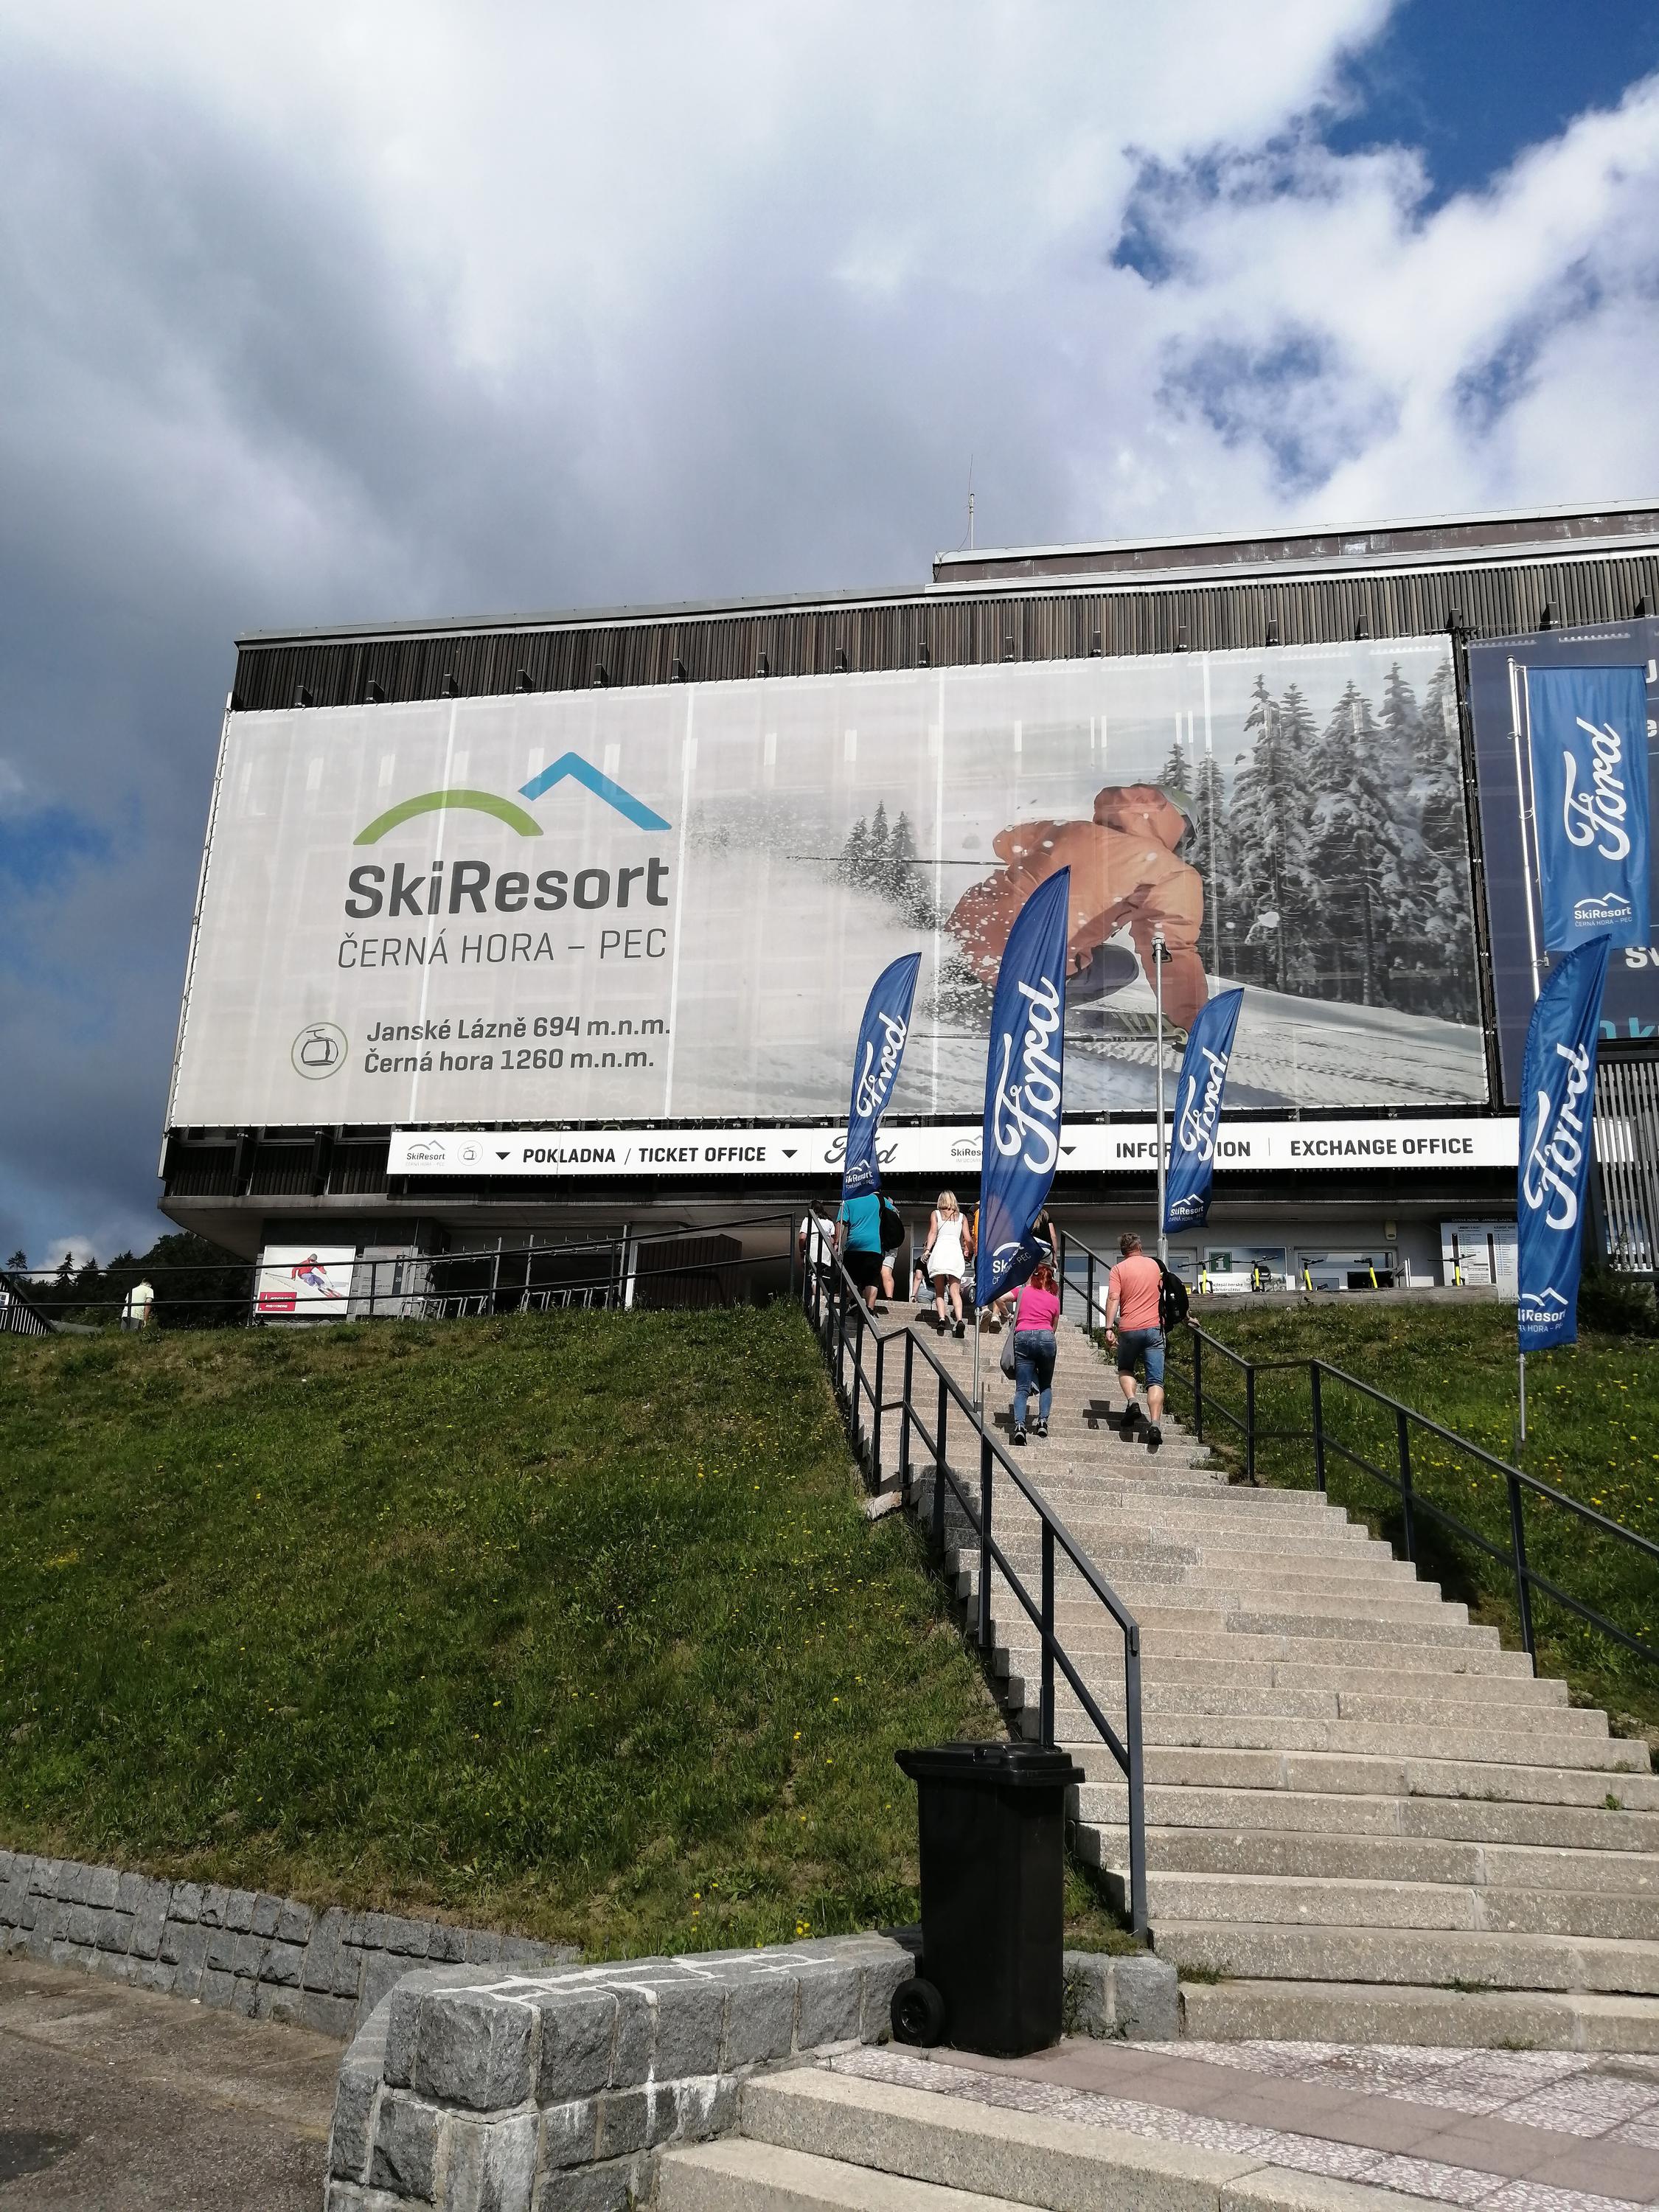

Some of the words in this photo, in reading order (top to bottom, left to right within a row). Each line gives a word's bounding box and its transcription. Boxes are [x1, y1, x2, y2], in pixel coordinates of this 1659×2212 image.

[1563, 716, 1630, 860] Ford
[344, 857, 669, 919] SkiResort
[1574, 906, 1632, 919] SkiResort
[338, 928, 448, 968] ČERNÁ
[461, 932, 554, 964] HORA
[600, 928, 667, 960] PEC
[366, 1018, 451, 1042] Janské
[458, 1017, 526, 1040] Lázně
[533, 1016, 580, 1037] 694
[587, 1019, 671, 1037] m.n.m.
[364, 1048, 433, 1074] Černá
[439, 1051, 493, 1071] hora
[501, 1048, 563, 1071] 1260
[570, 1052, 654, 1068] m.n.m.
[994, 976, 1061, 1175] Ford
[1180, 1046, 1229, 1162] Ford
[824, 1135, 899, 1164] Fd
[1290, 1139, 1397, 1156] EXCHANGE
[1402, 1138, 1473, 1155] OFFICE
[1523, 1043, 1590, 1230] Ford
[406, 1152, 445, 1161] SkiResort
[523, 1148, 616, 1164] POKLADNA
[639, 1147, 699, 1163] TICKET
[704, 1147, 766, 1162] OFFICE
[950, 1148, 983, 1157] SkiRes
[1016, 1252, 1032, 1264] PEC
[1527, 1324, 1548, 1332] HORA
